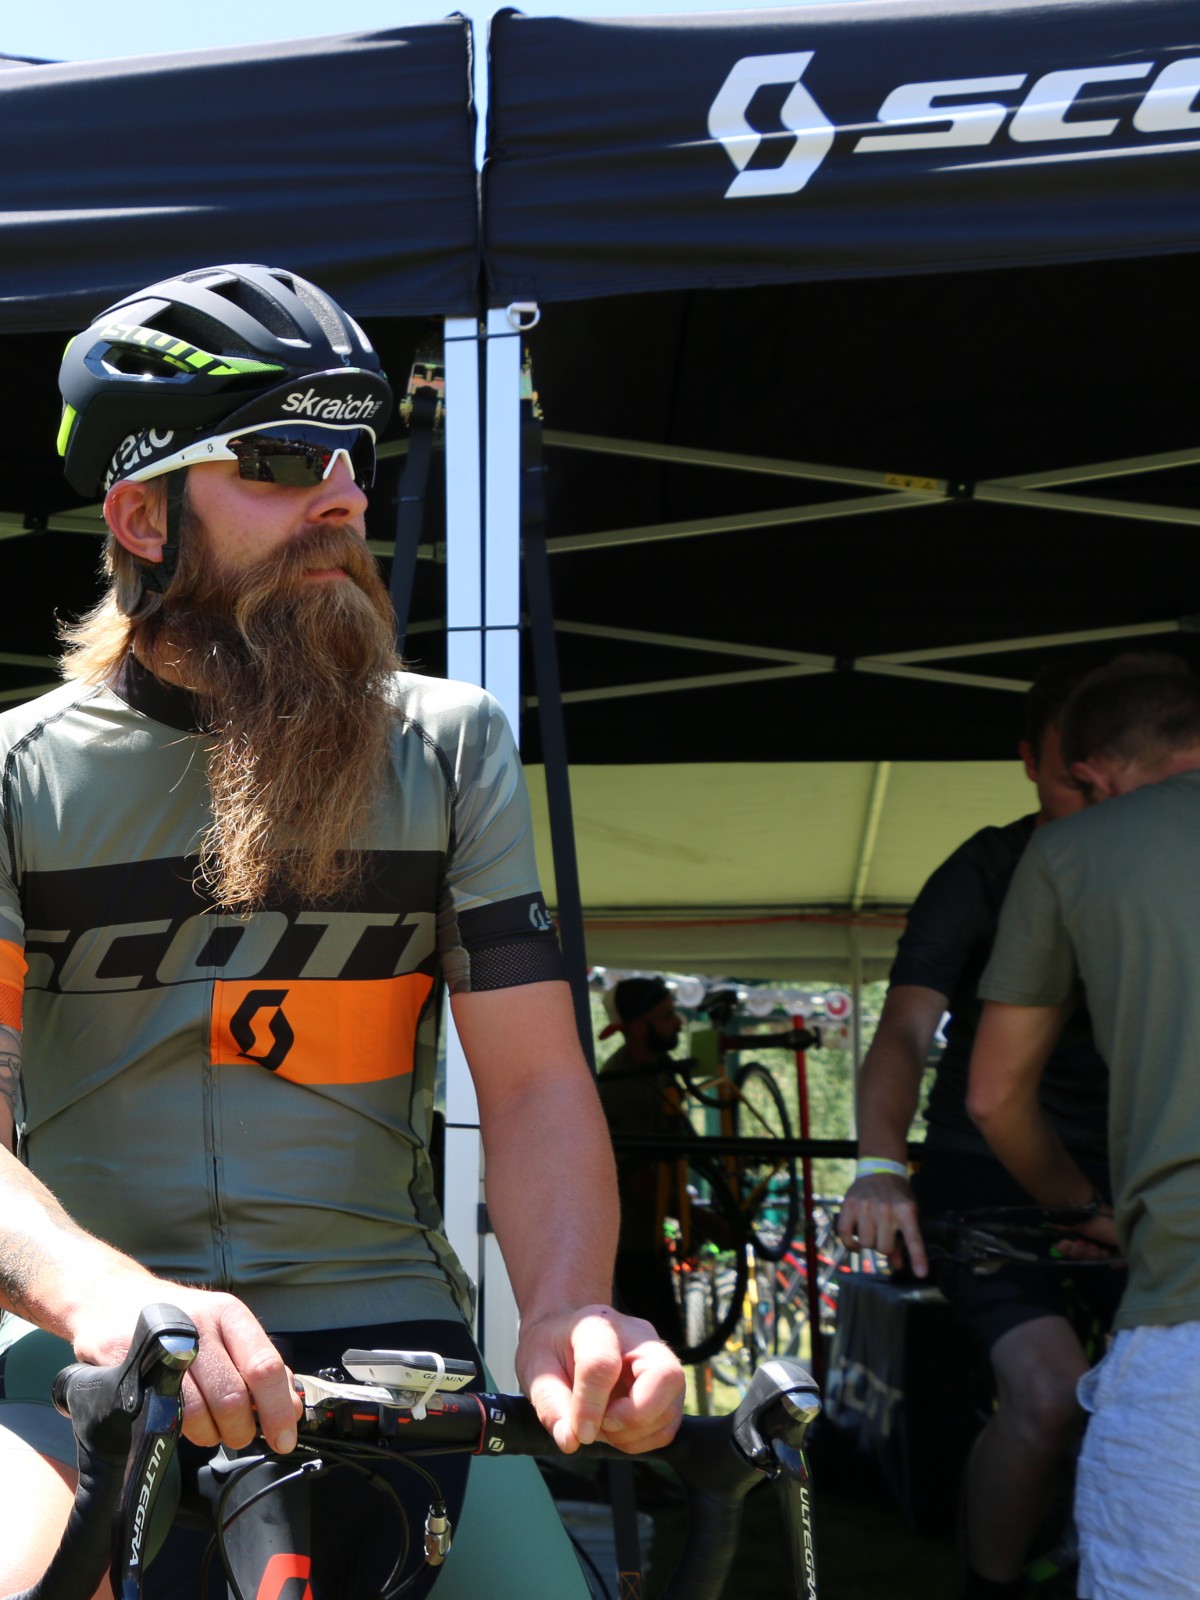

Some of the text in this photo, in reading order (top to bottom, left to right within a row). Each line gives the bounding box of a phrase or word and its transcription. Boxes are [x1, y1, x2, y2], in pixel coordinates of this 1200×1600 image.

[281, 388, 375, 419] skratch
[422, 1373, 465, 1383] GAMIN
[129, 1437, 166, 1567] ULTEGRA
[799, 1486, 818, 1600] ULTEGRA
